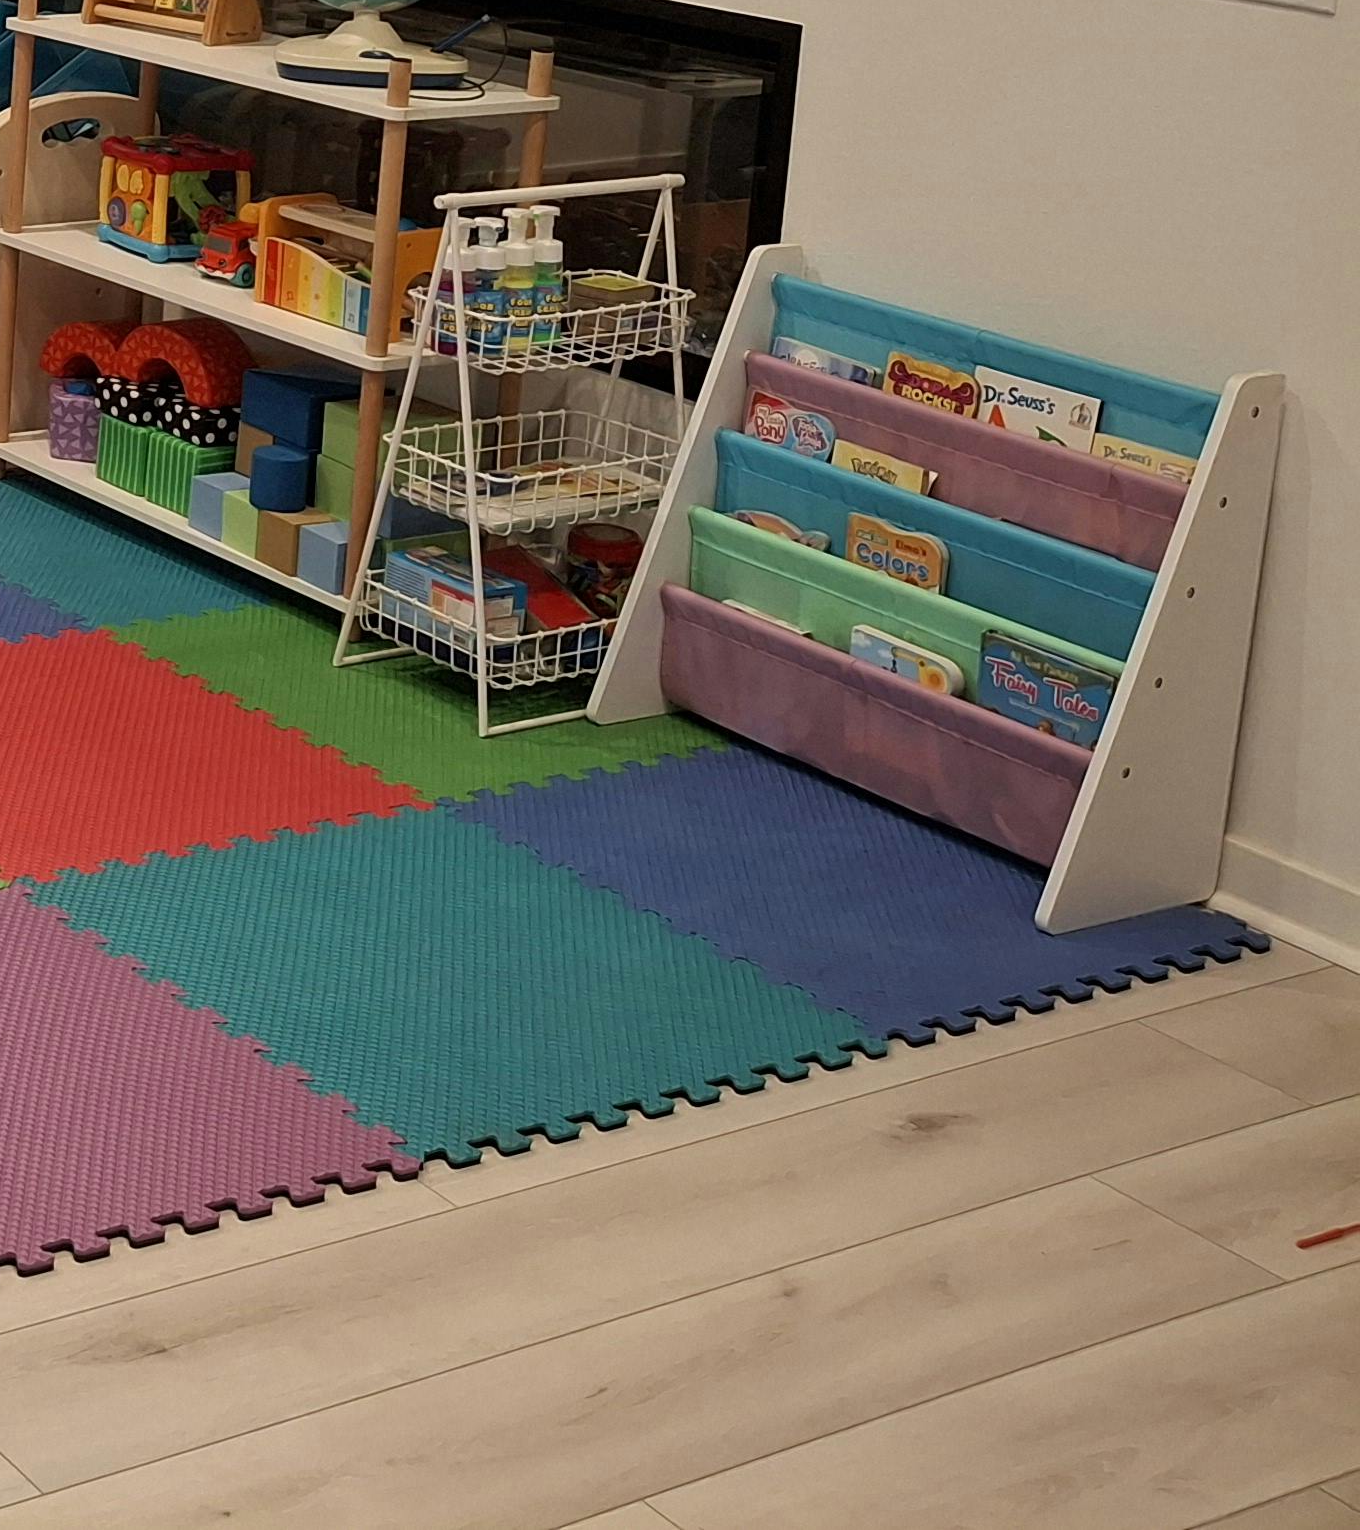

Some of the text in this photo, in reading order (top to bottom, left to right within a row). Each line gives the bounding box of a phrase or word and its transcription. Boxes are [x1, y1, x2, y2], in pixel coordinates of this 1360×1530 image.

[901, 383, 958, 414] ROCKS!
[983, 385, 1056, 415] Dr. Seuss's
[755, 416, 786, 440] Pony
[1103, 445, 1117, 459] Dr.
[856, 542, 929, 582] Colors
[985, 656, 1038, 704] Fairy
